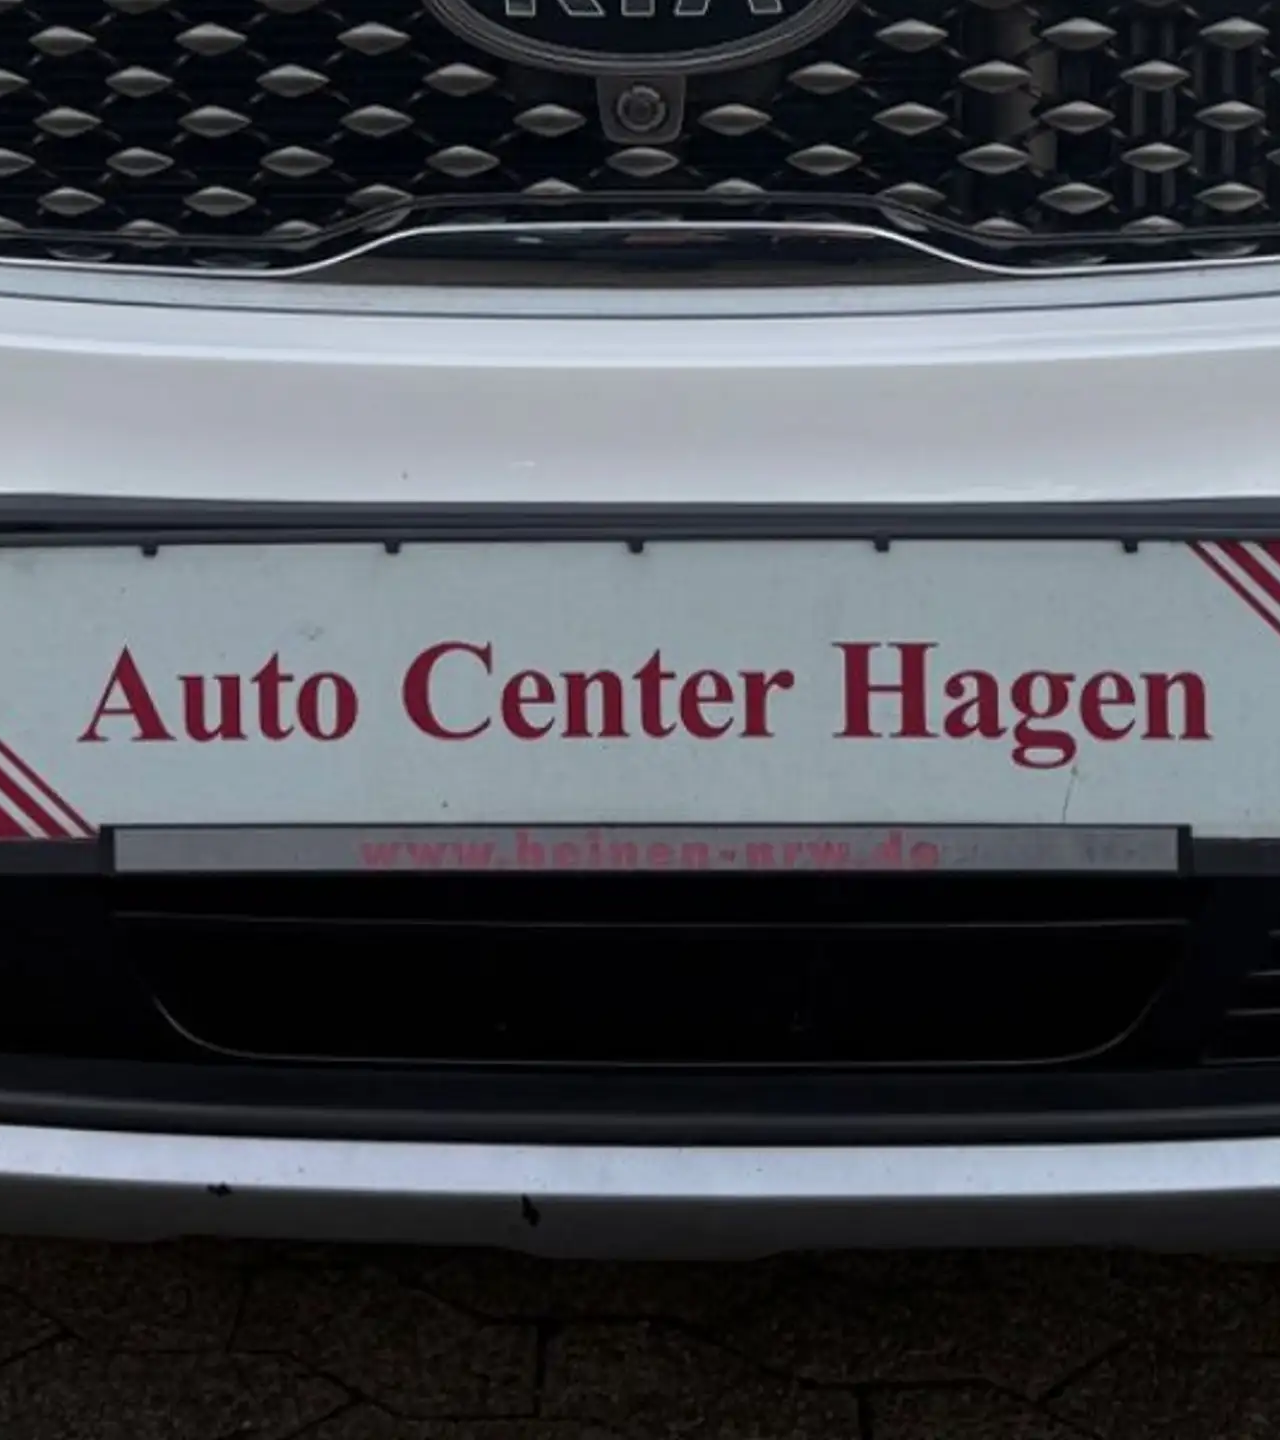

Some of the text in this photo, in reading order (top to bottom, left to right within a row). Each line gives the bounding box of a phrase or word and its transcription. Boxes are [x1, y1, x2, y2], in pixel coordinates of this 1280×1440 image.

[77, 641, 1213, 769] Auto Center Hagen
